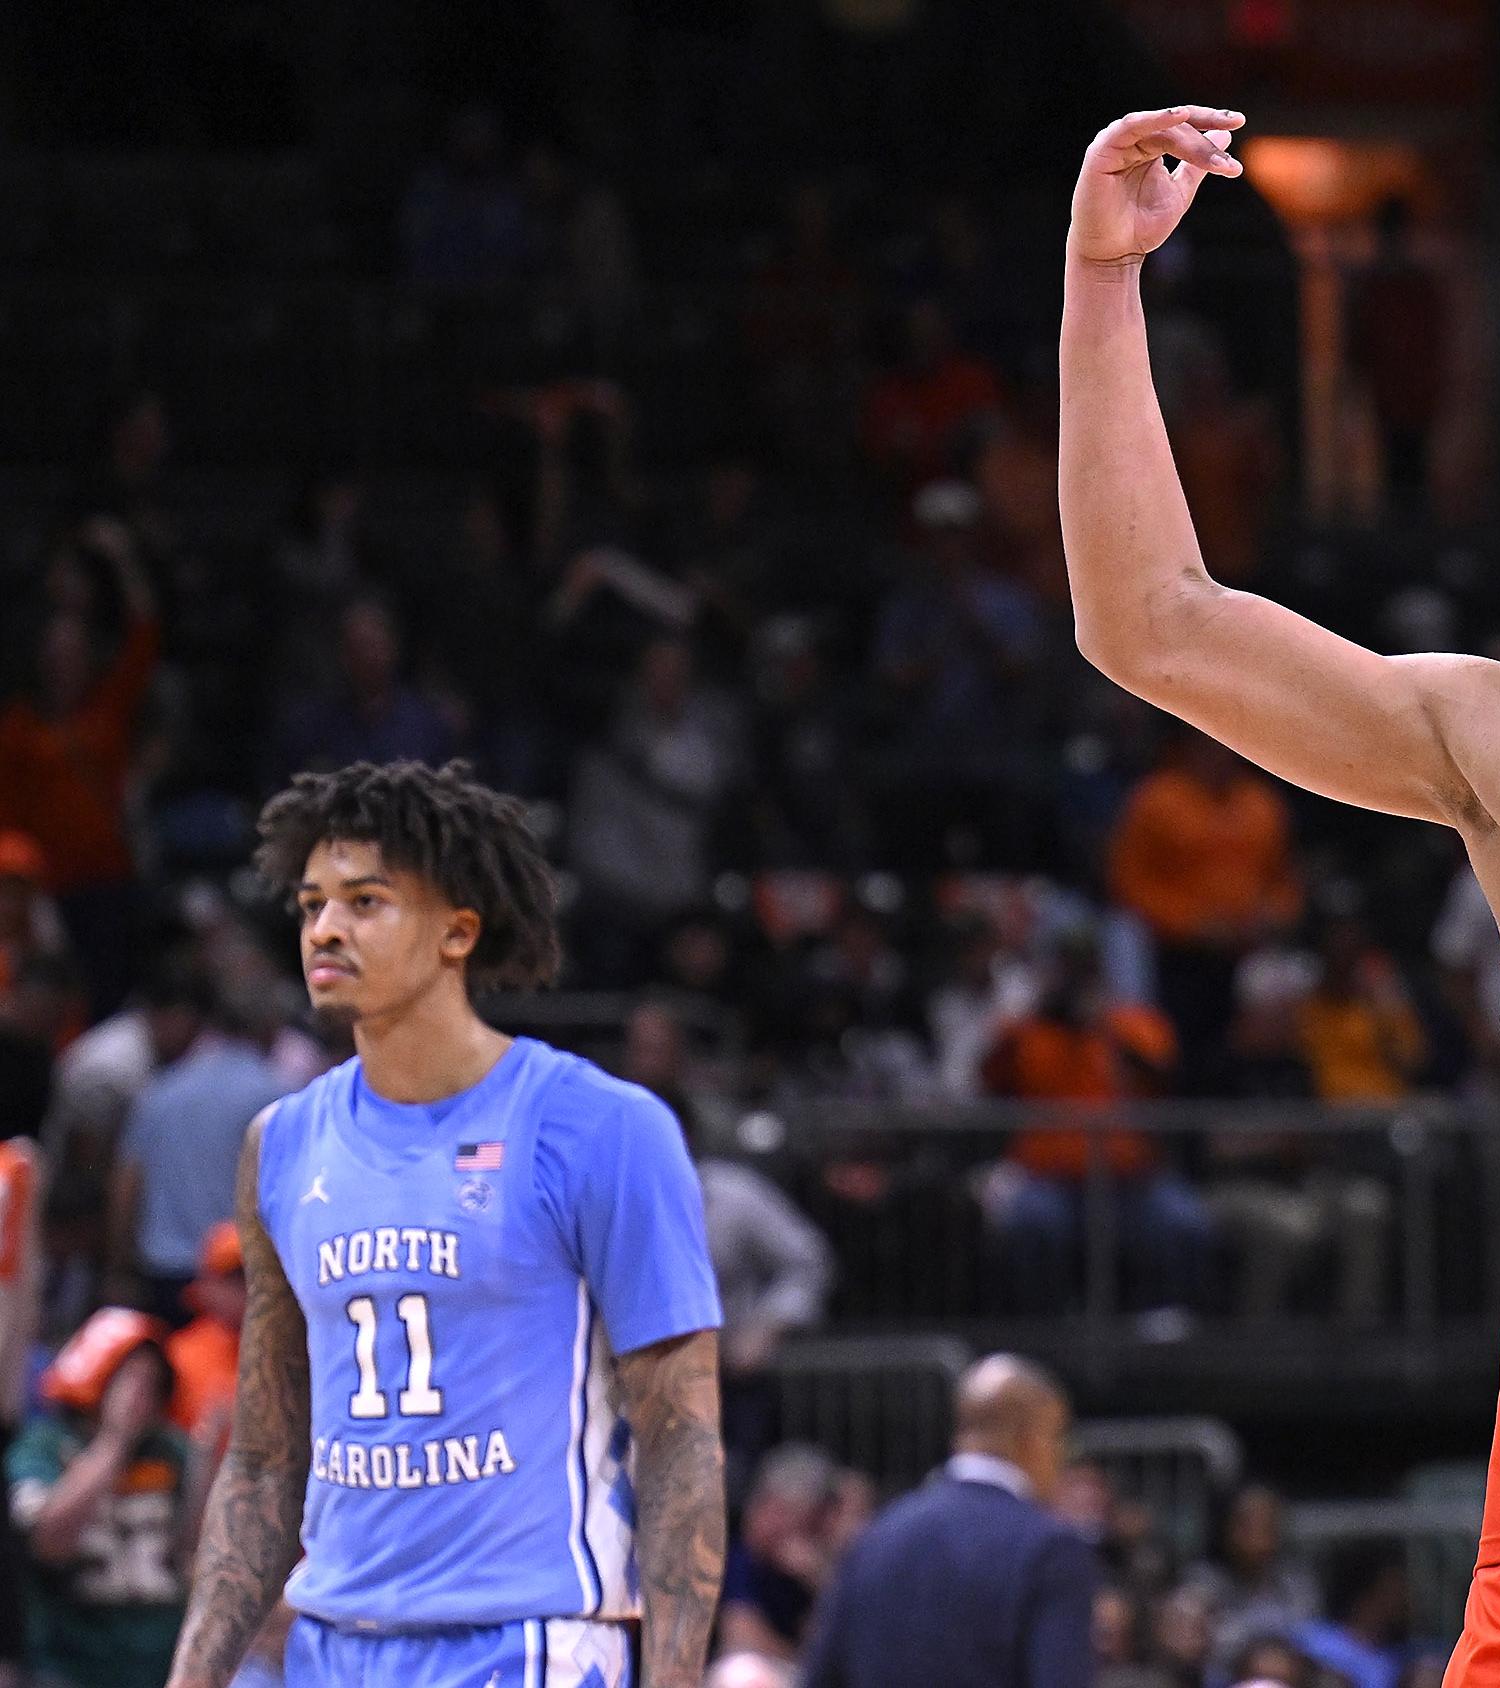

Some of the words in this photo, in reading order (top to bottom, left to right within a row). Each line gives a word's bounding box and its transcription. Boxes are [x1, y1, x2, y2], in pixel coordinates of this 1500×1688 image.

[318, 1227, 460, 1285] NORTH
[347, 1294, 443, 1417] 11
[312, 1430, 515, 1489] CAROLINA
